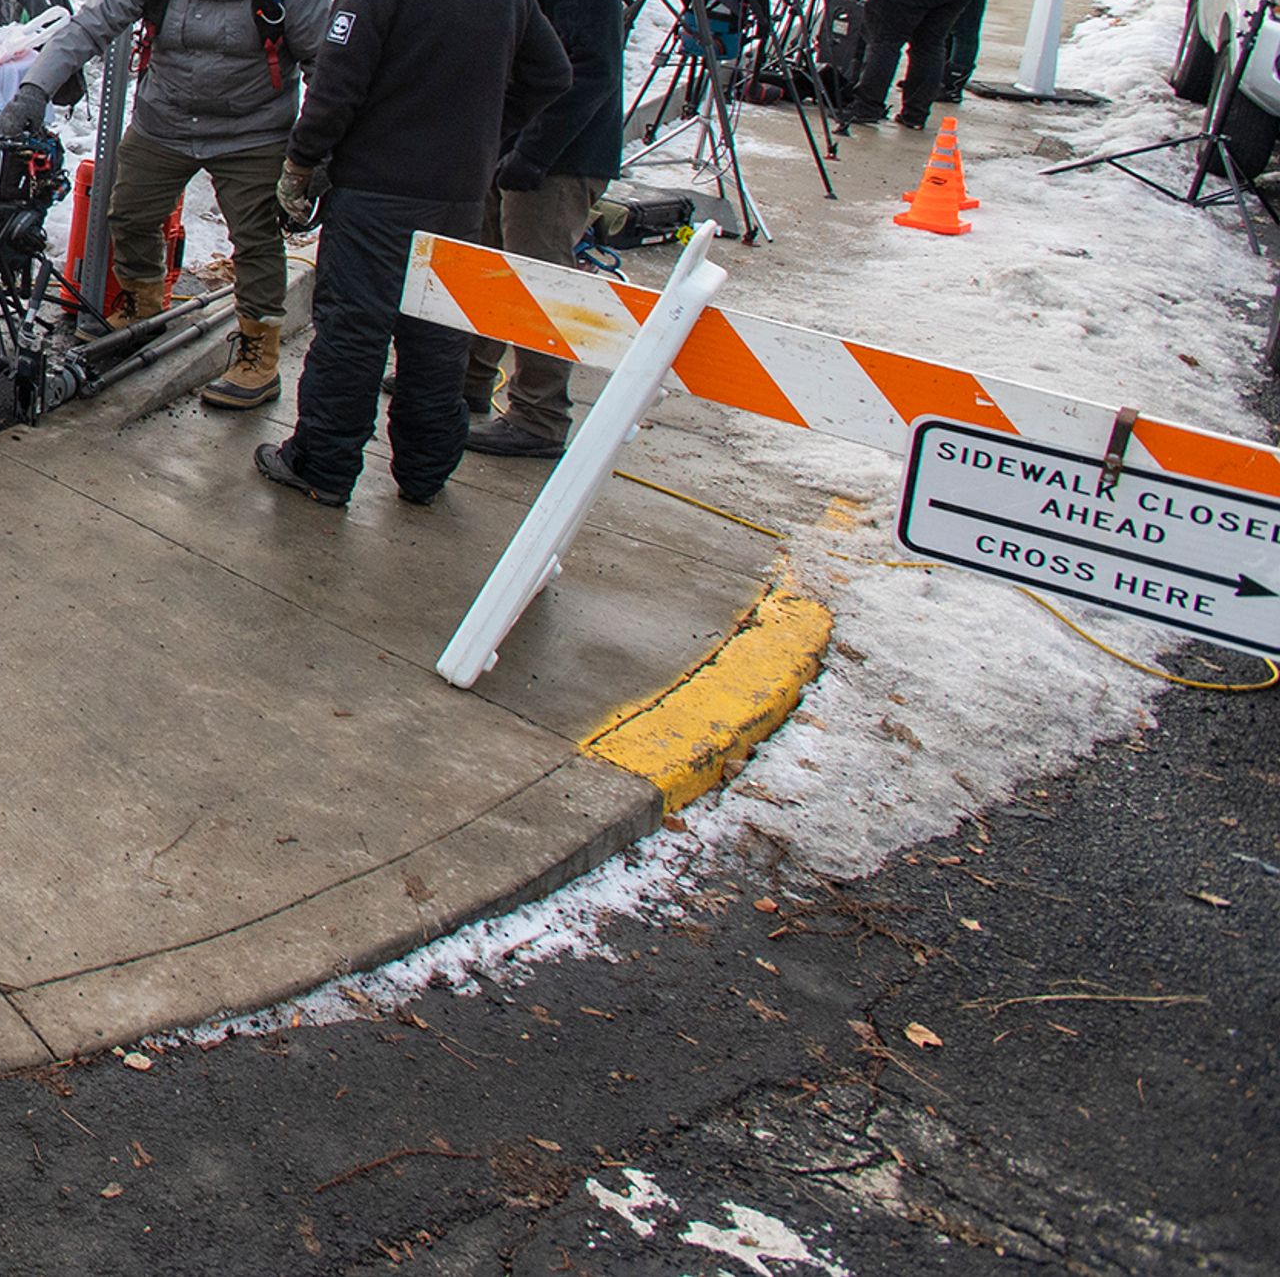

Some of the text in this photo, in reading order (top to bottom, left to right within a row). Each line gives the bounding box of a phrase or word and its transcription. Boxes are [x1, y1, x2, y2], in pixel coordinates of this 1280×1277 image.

[936, 440, 1118, 503] SIDEWALK
[1039, 498, 1167, 545] AHEAD
[975, 534, 1217, 617] CROSS HERE
